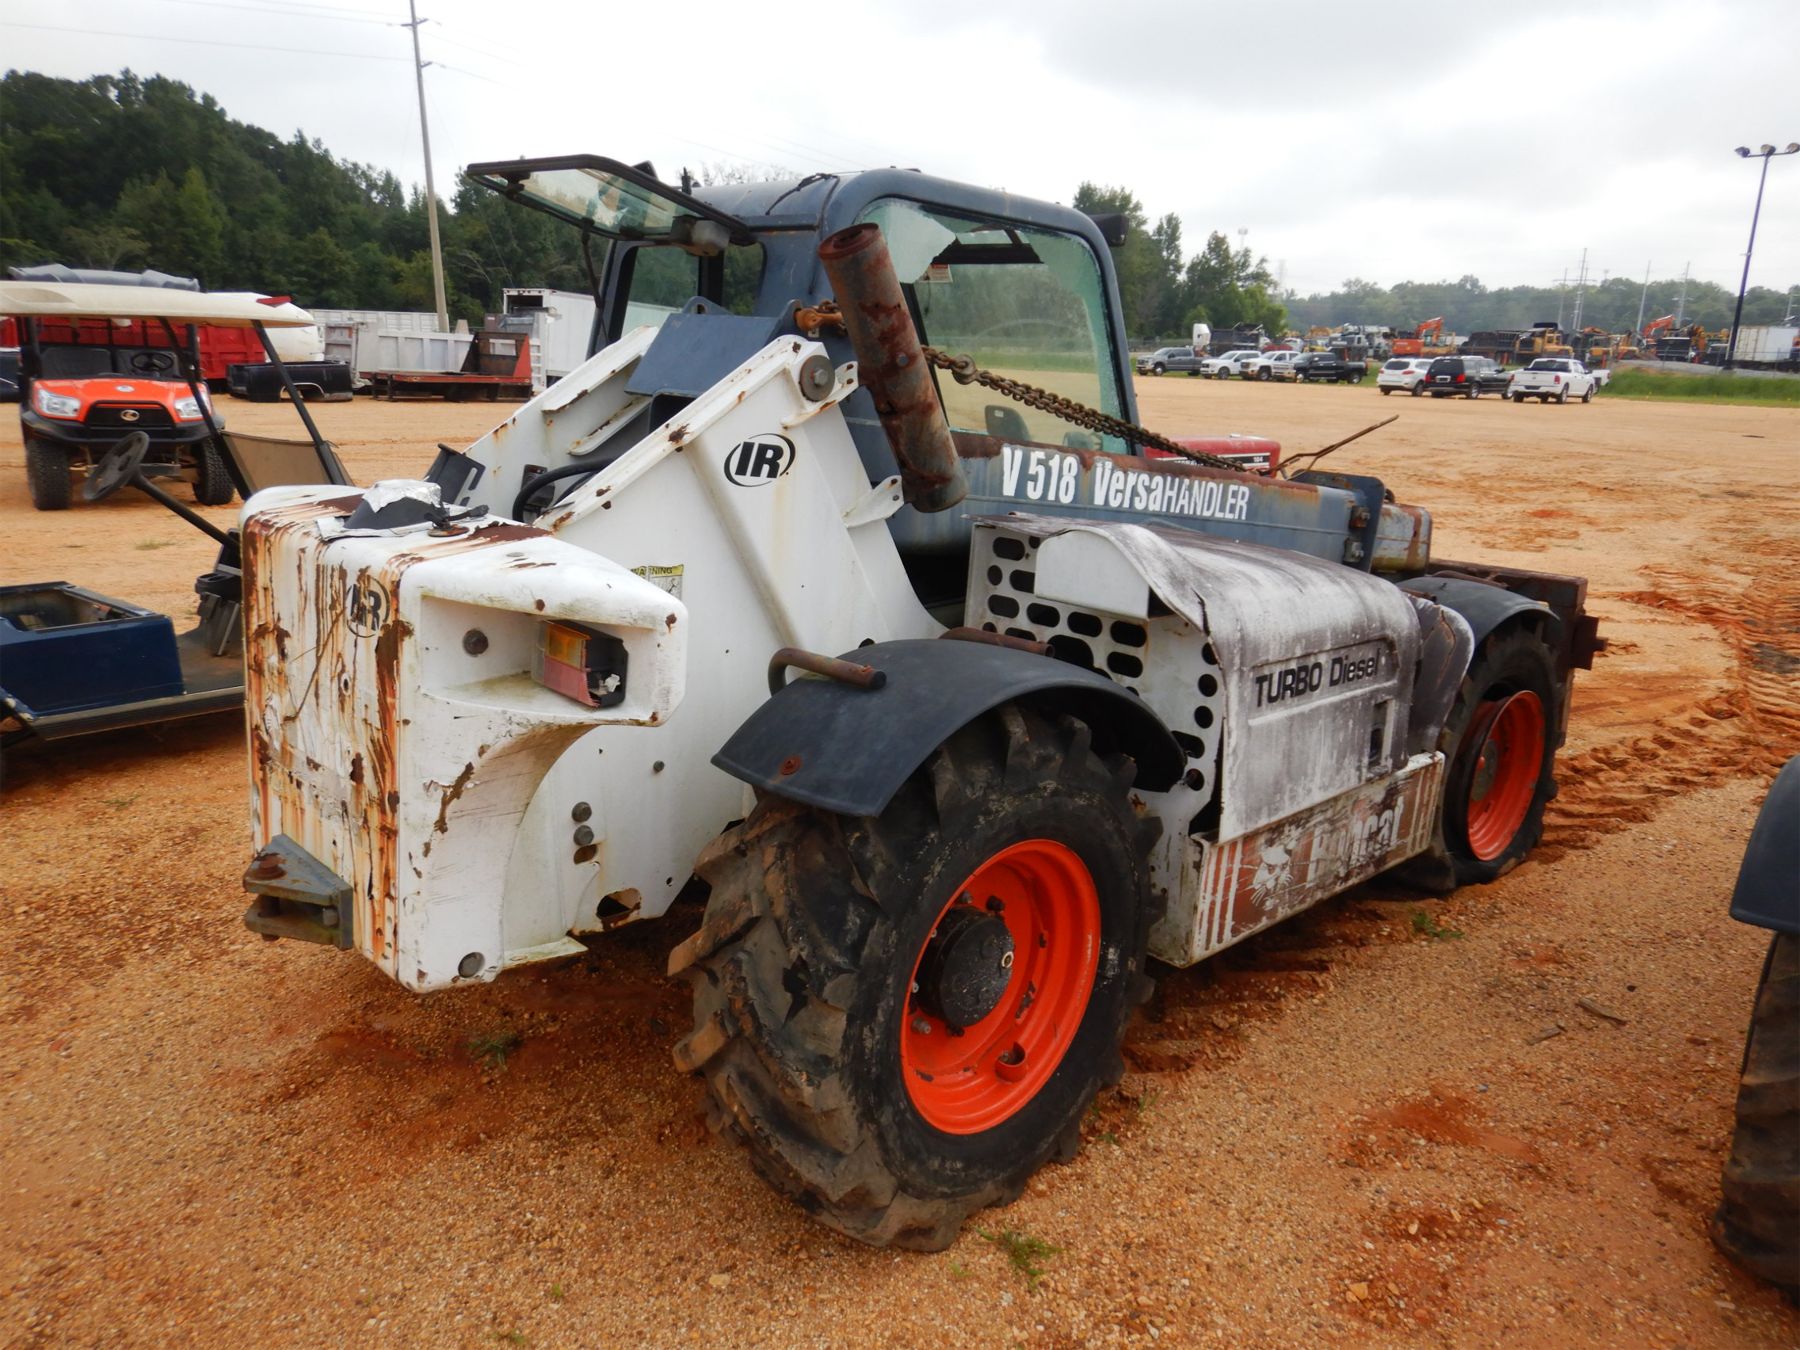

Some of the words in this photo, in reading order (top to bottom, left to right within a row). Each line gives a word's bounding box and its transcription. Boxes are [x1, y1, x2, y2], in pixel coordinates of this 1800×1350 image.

[735, 441, 784, 478] IR
[1002, 446, 1024, 497] V
[1026, 450, 1079, 505] 518
[1255, 661, 1323, 707] TURBO
[1329, 647, 1382, 687] Diesel
